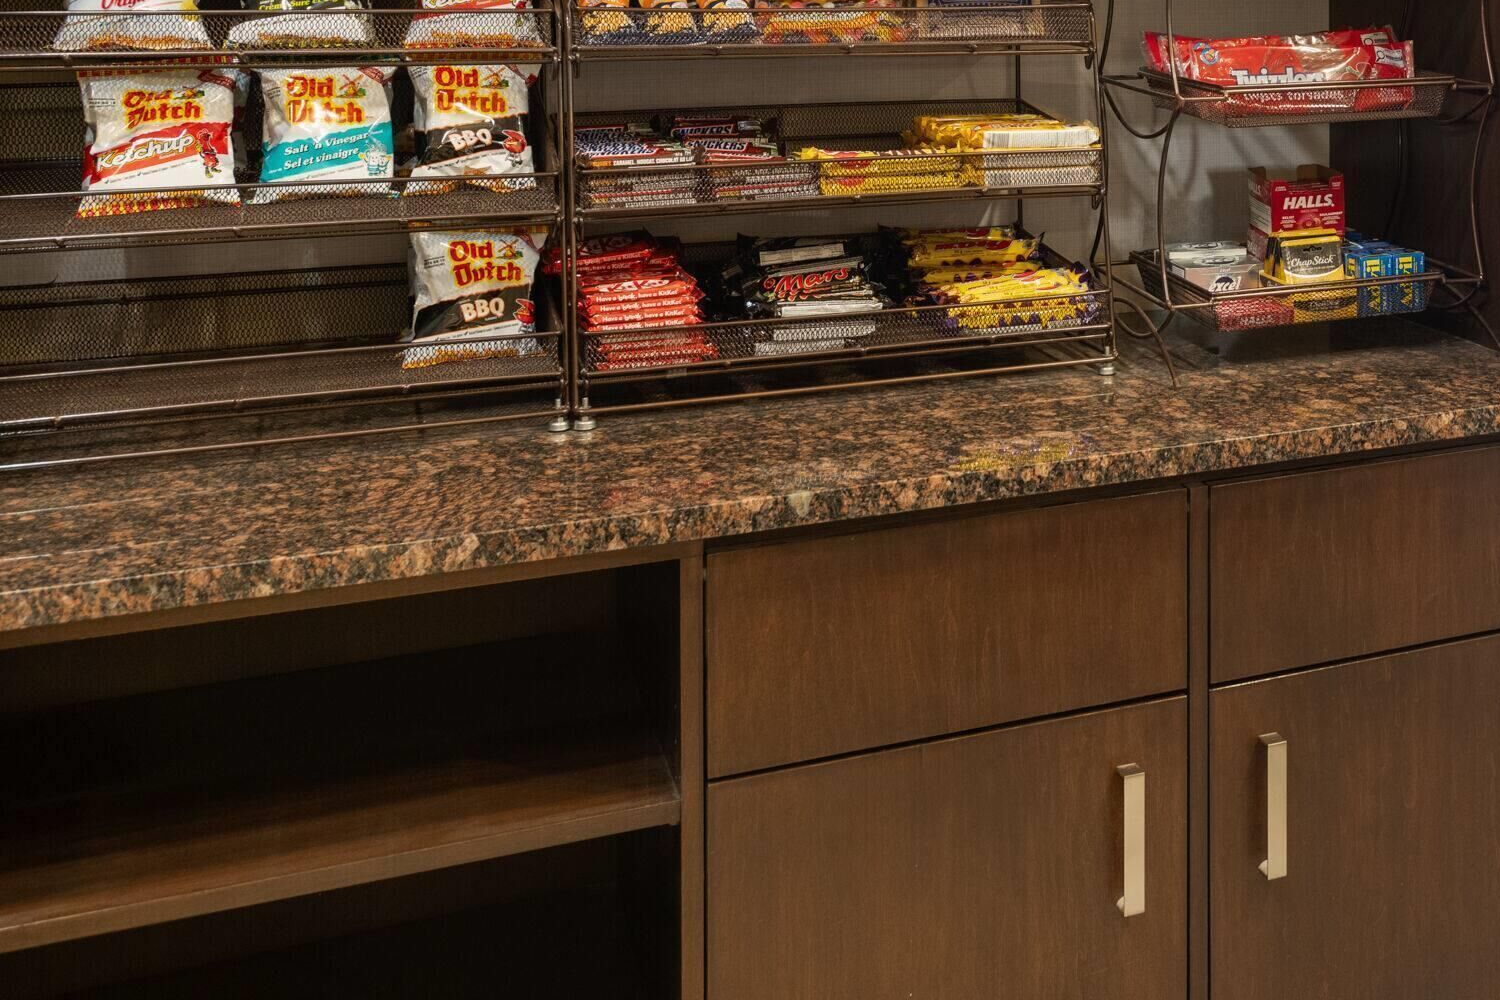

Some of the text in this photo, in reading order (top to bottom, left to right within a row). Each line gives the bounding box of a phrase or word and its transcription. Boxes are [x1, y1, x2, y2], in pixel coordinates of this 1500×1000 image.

[290, 0, 310, 8] Sure
[287, 76, 334, 98] Old
[435, 66, 479, 88] Old
[284, 145, 309, 156] Salt
[325, 132, 369, 147] Vinegar
[448, 128, 493, 151] BBQ
[95, 133, 195, 172] Ketchup
[283, 146, 359, 171] Sel et vinaigre
[449, 241, 493, 262] Old
[1291, 254, 1334, 268] ChapStick
[453, 262, 522, 287] Dutch
[774, 267, 849, 294] Mars
[460, 297, 506, 323] BBQ
